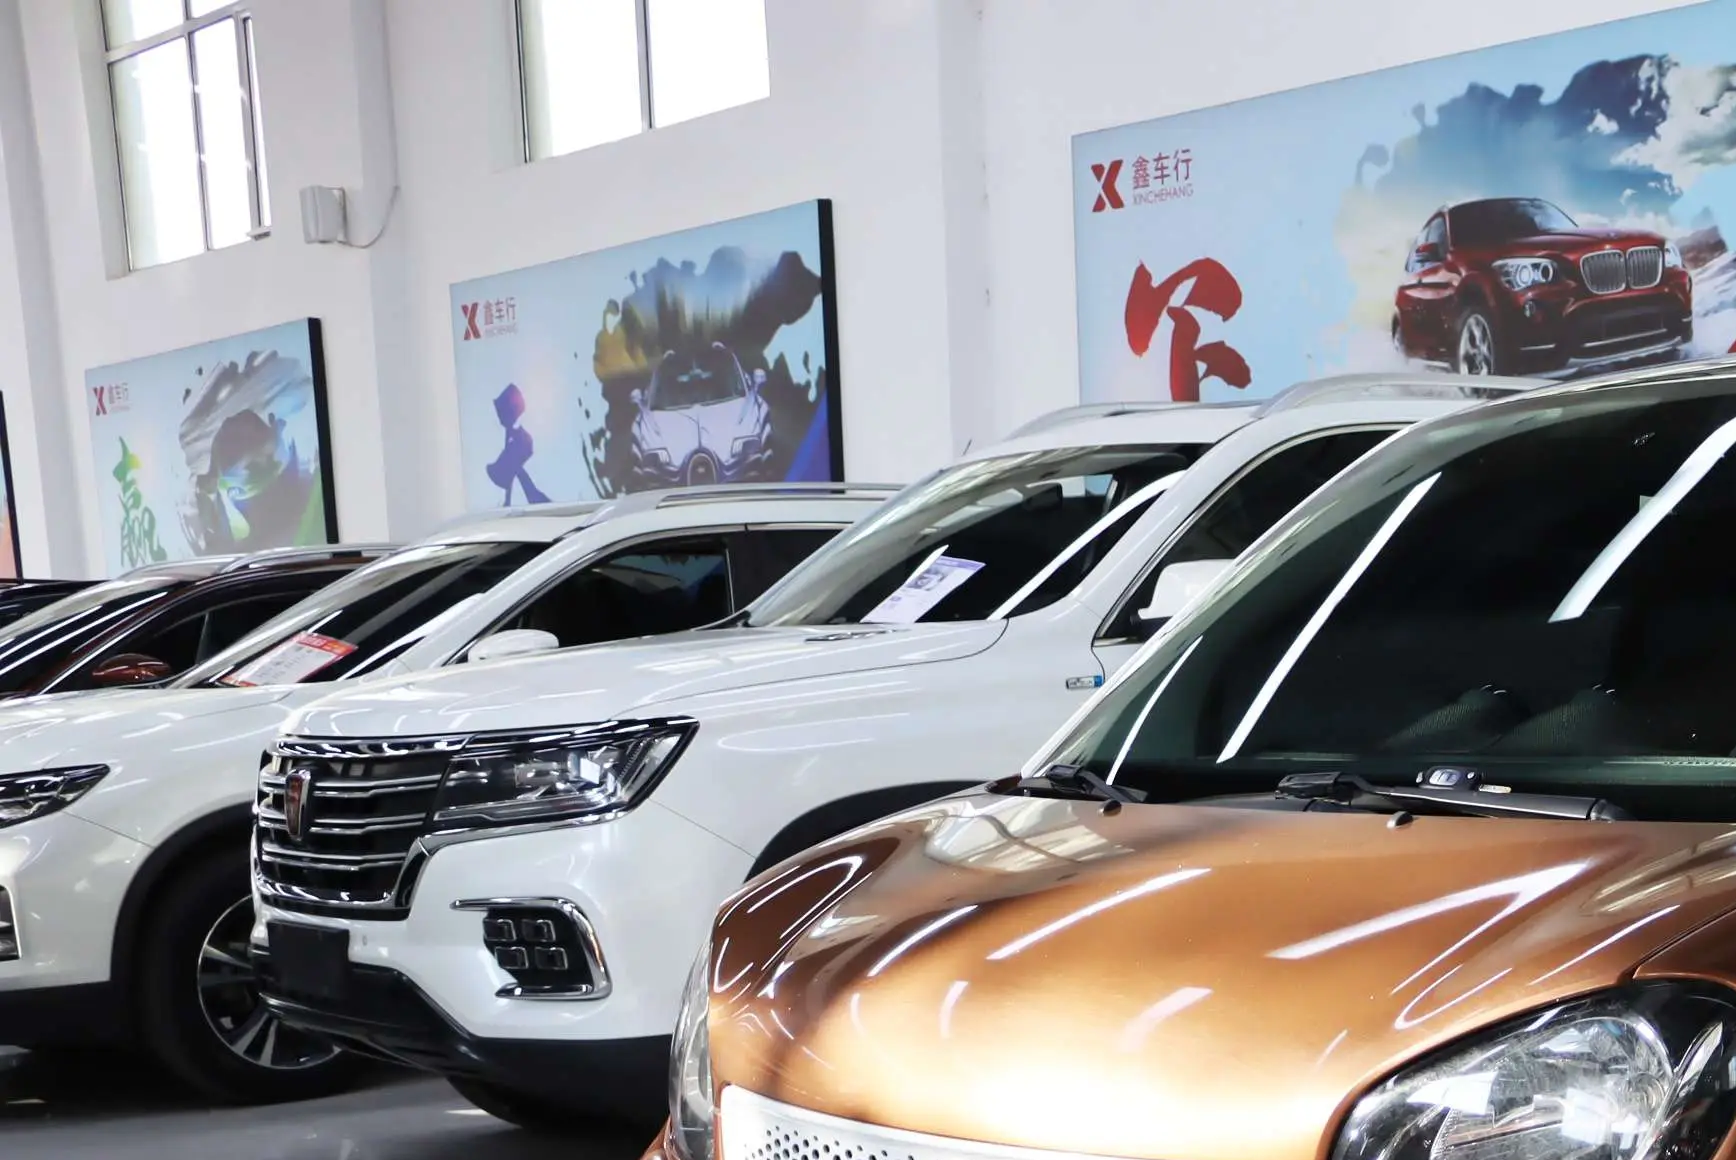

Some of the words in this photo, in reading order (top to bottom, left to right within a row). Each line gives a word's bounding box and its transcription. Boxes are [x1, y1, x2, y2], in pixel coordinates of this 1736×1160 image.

[1132, 148, 1193, 190] 鑫车行
[1132, 183, 1194, 206] XINCHEHANG
